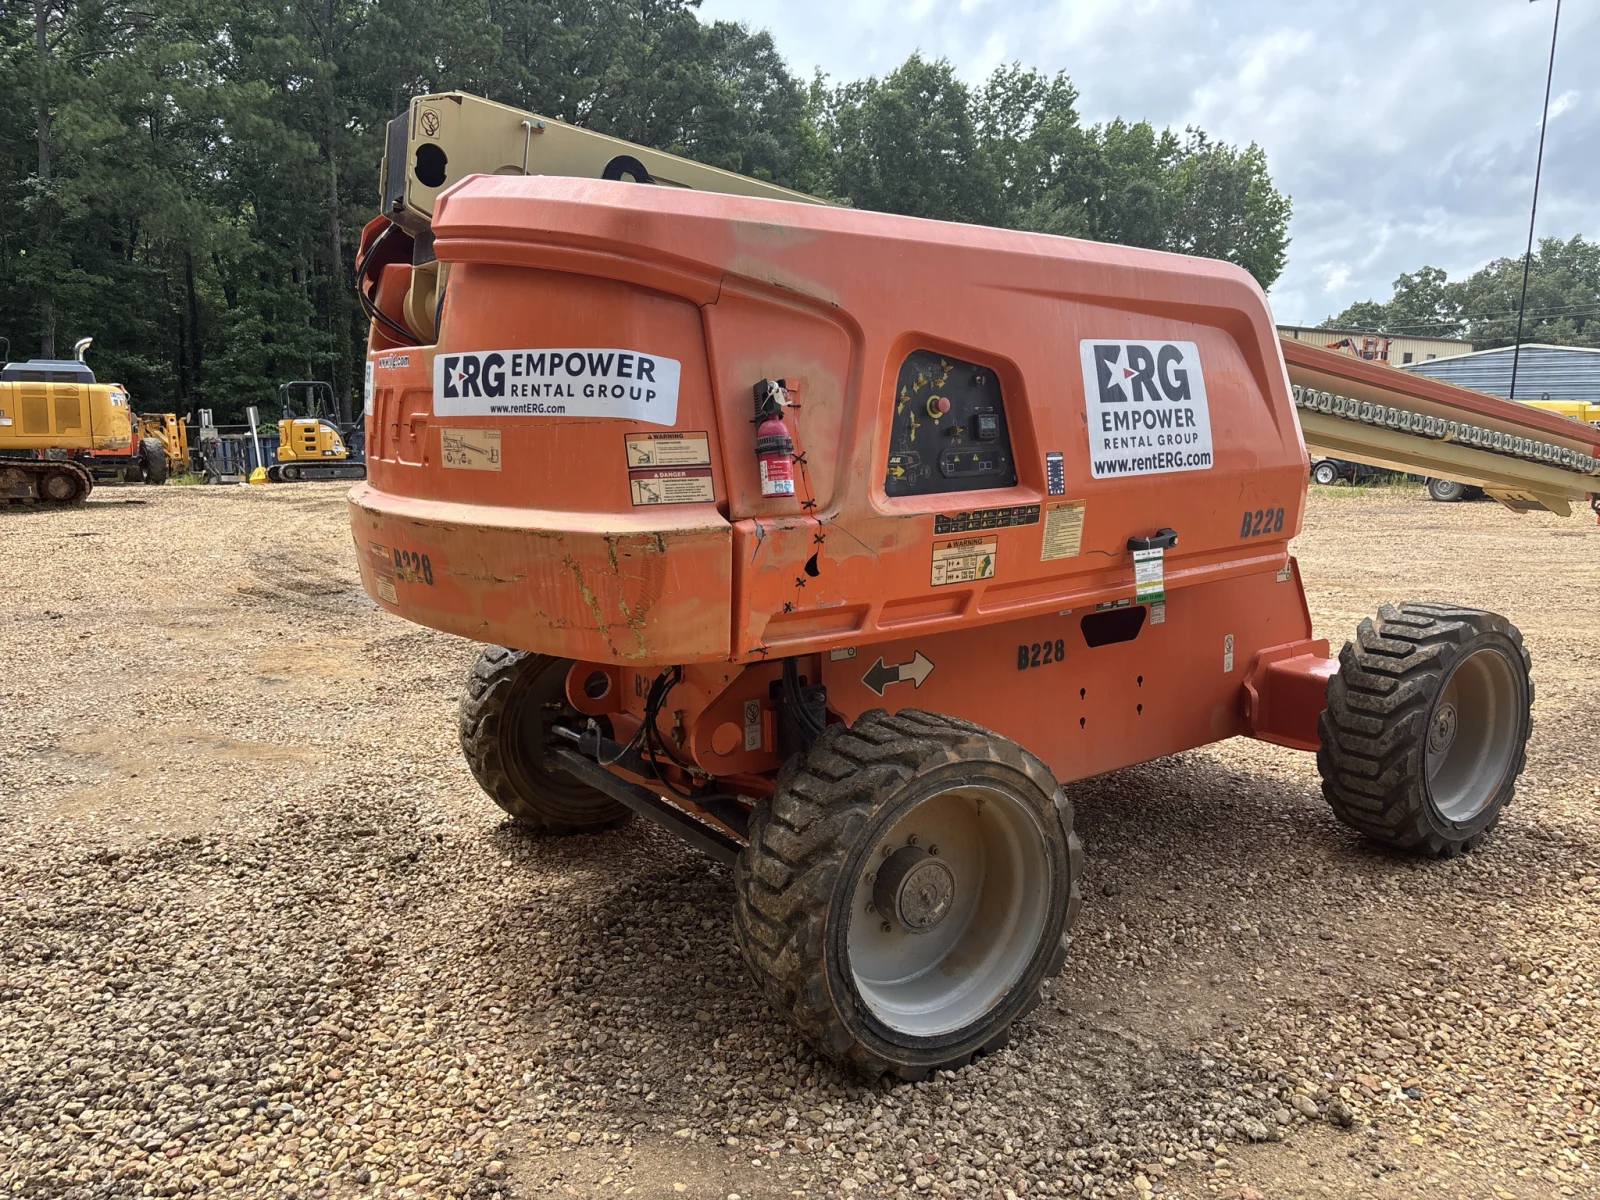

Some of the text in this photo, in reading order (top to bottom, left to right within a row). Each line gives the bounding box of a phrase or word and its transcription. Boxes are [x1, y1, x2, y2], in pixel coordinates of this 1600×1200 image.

[443, 353, 506, 398] ERG
[511, 352, 656, 383] EMPOWER
[1093, 344, 1192, 403] ERG
[511, 384, 656, 403] RENTAL GROUP
[490, 403, 566, 414] www.rentERG.com
[1101, 408, 1197, 432] EMPOWER
[1104, 432, 1199, 450] RENTAL GROUP
[1094, 451, 1212, 475] www.rentERG.com
[1240, 507, 1285, 538] B228
[953, 538, 983, 548] WARNING
[1017, 638, 1065, 671] B228
